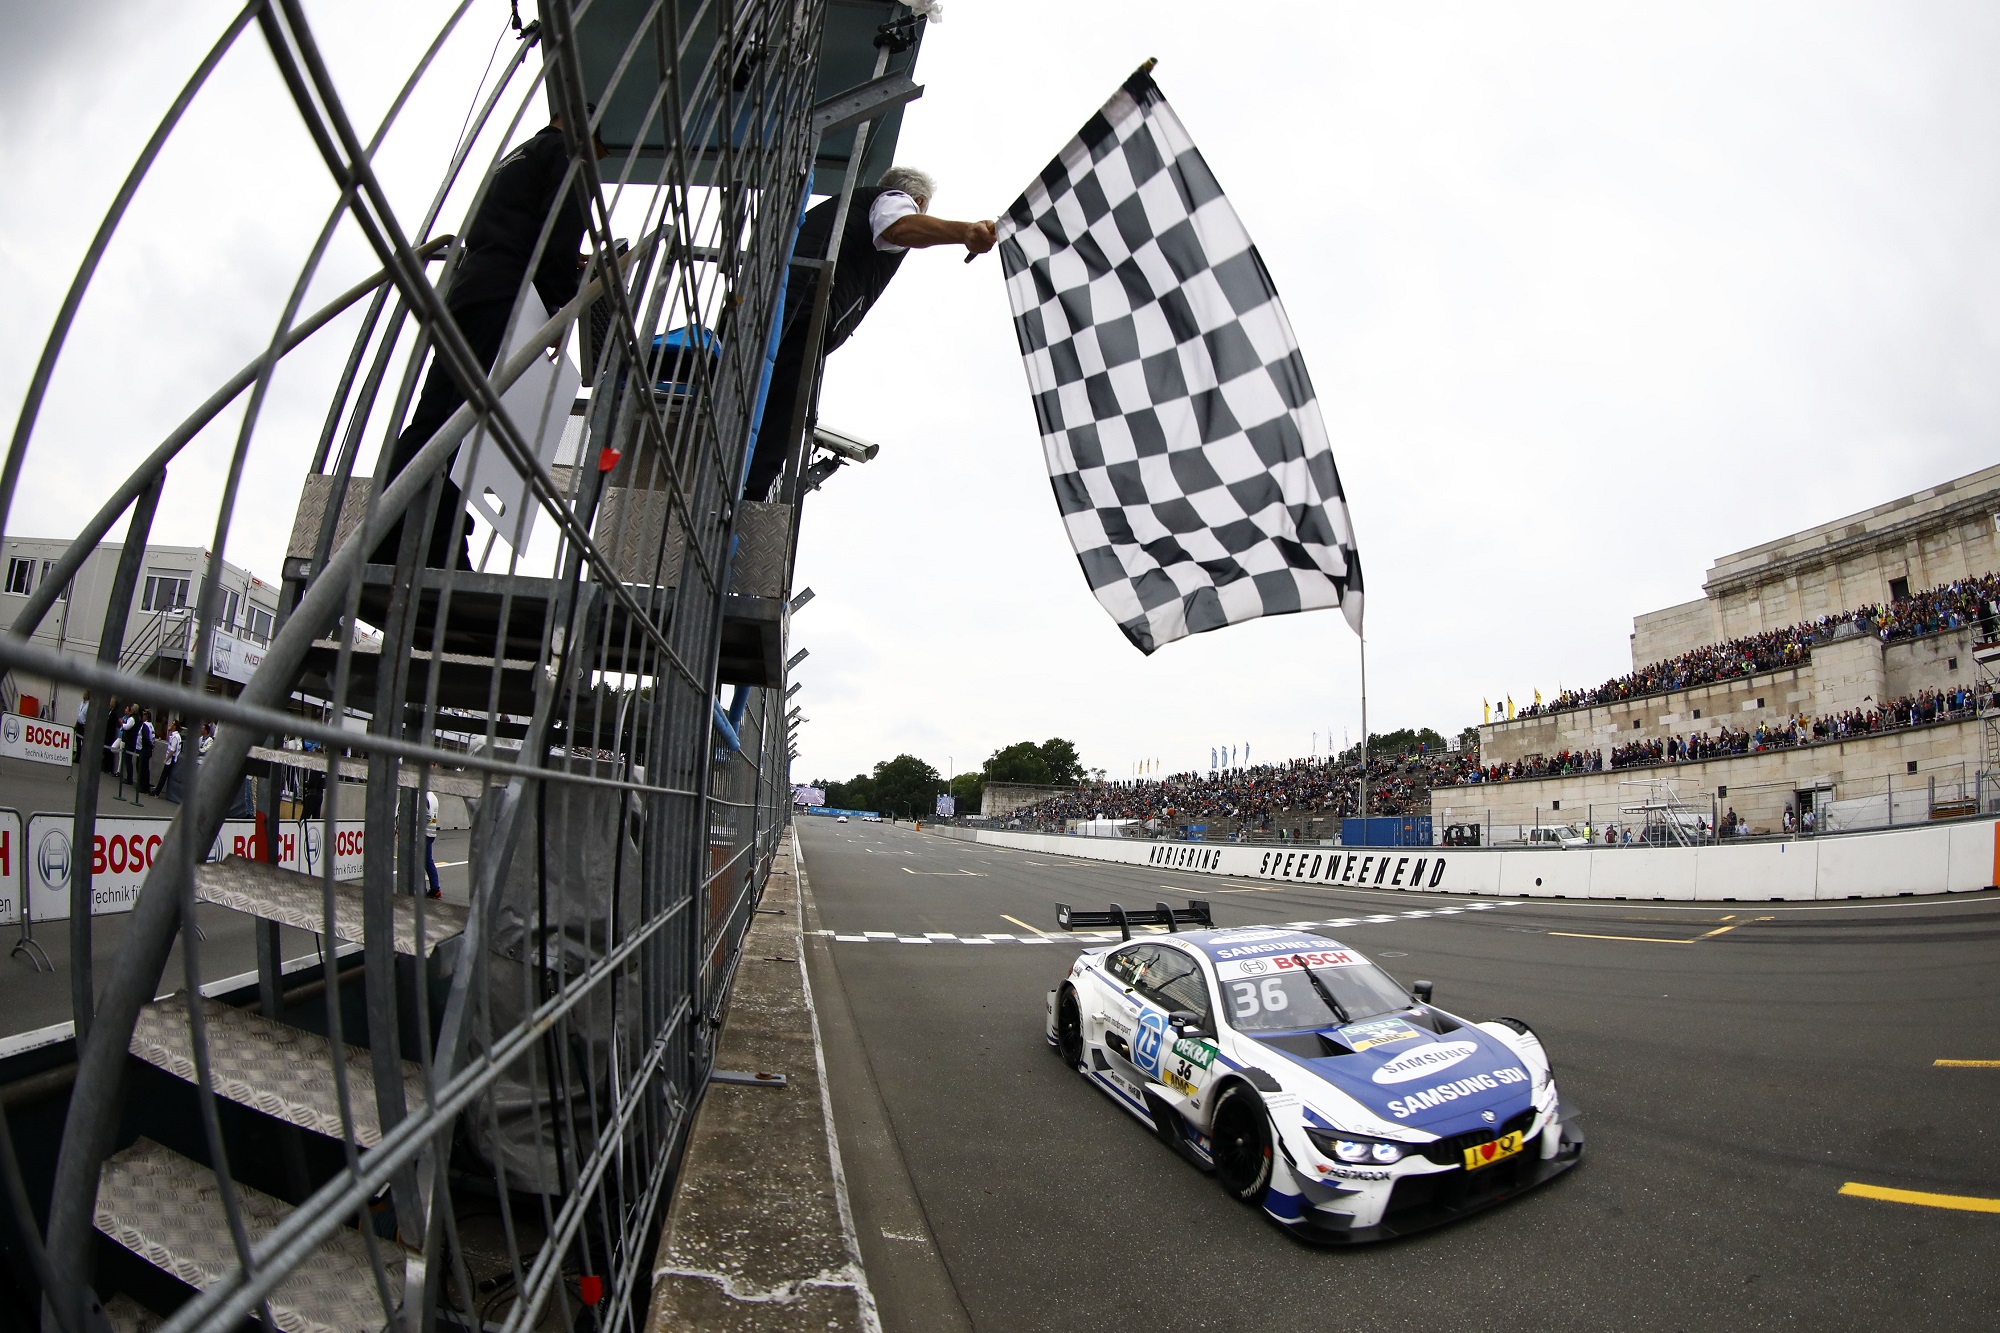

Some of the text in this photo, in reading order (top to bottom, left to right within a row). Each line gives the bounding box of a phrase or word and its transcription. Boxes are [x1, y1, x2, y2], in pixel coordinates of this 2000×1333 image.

[25, 724, 71, 750] BOSCH
[25, 747, 43, 758] Technik
[54, 753, 69, 763] Leben
[1149, 845, 1447, 888] NORISRING SPEEDWEEKEND
[91, 886, 131, 905] Technik
[1216, 940, 1342, 959] SAMSUNG SDI
[1272, 952, 1353, 970] BOSCH
[1232, 977, 1289, 1018] 36
[1343, 1021, 1400, 1034] DEKRA
[1176, 1038, 1211, 1066] DEKRA
[1383, 1046, 1472, 1074] SAMSUNG
[1177, 1059, 1194, 1081] 36
[1387, 1066, 1529, 1119] SAMSUNG SDI
